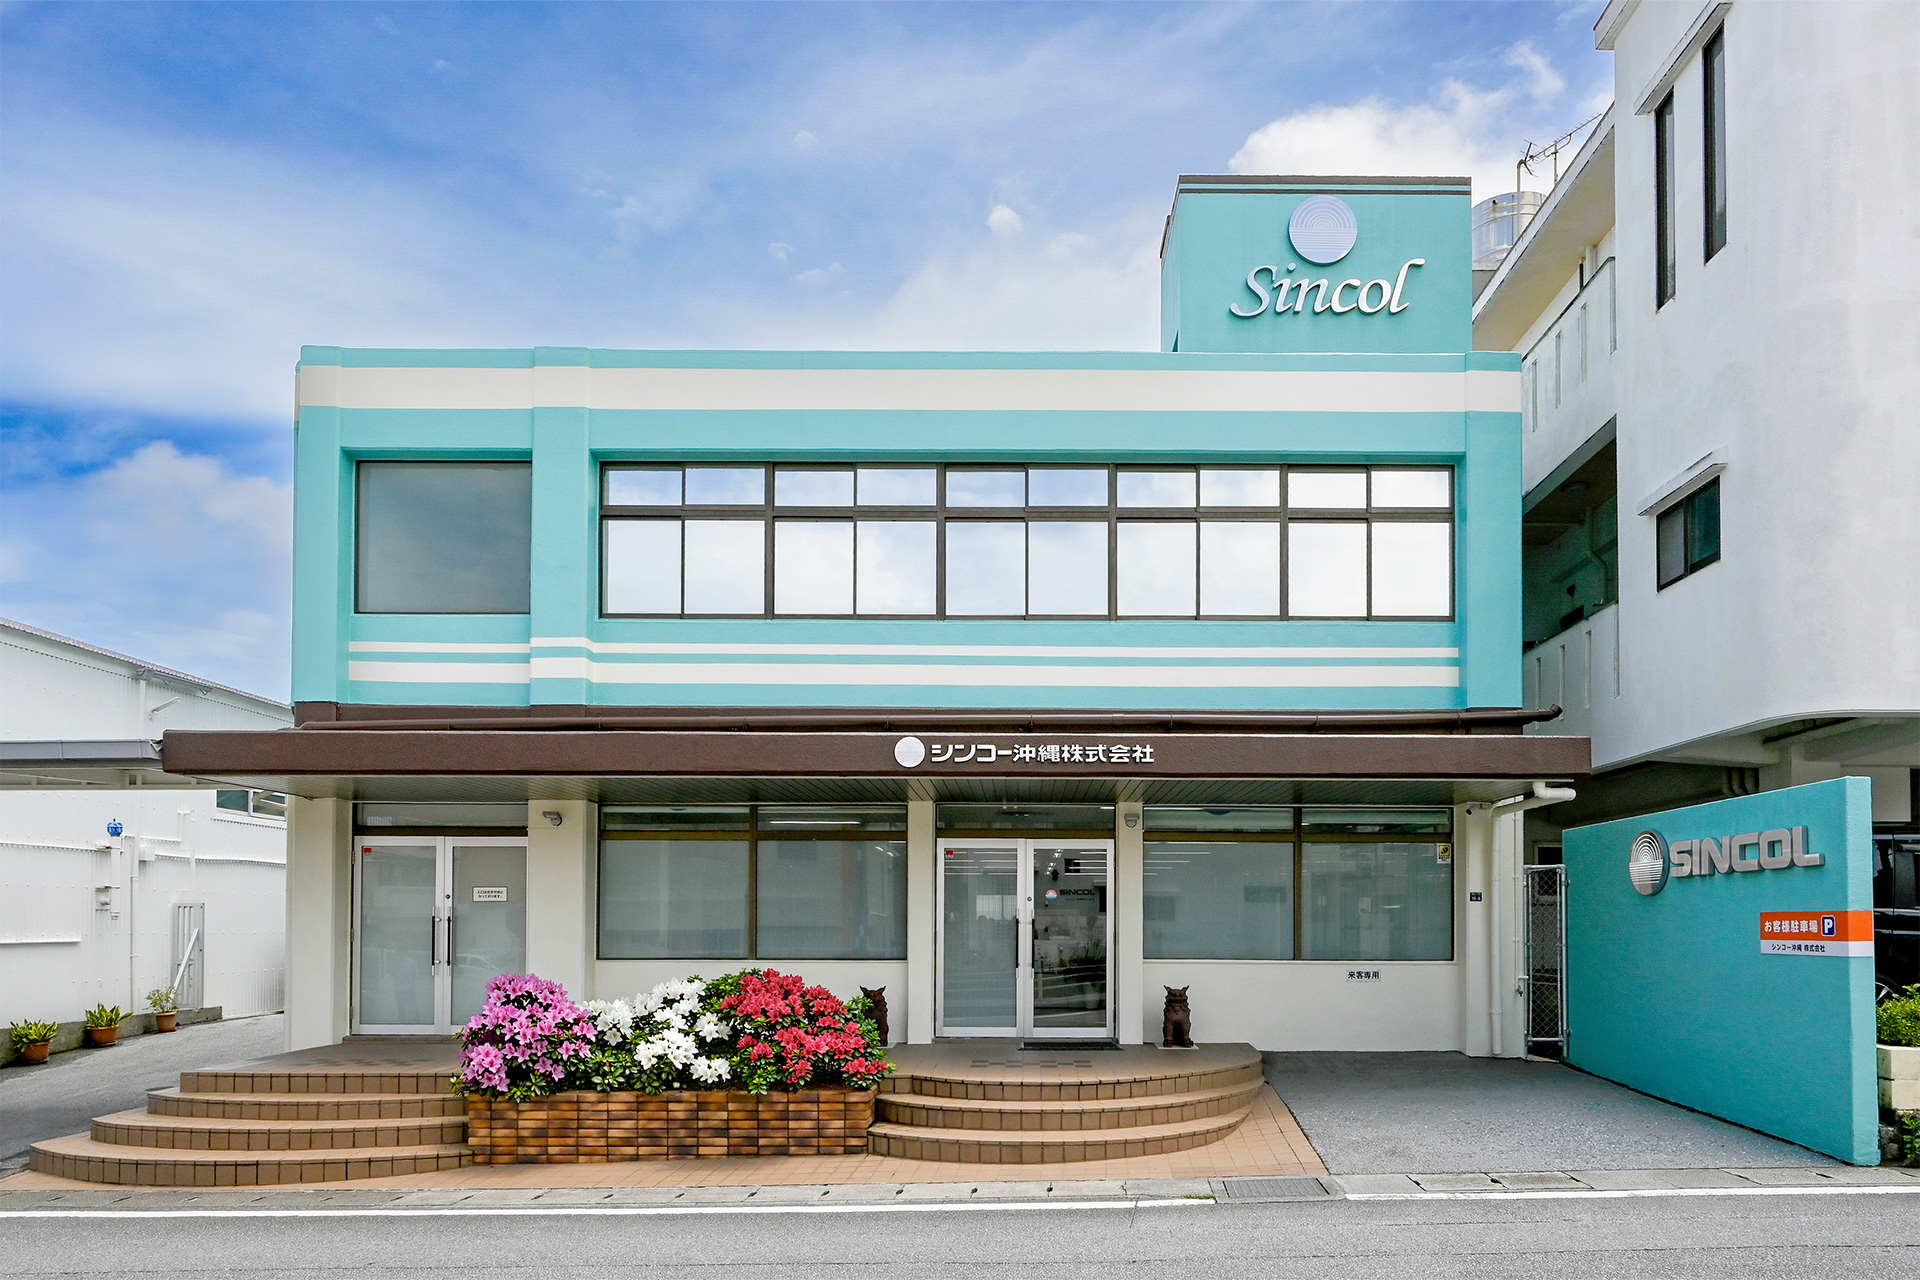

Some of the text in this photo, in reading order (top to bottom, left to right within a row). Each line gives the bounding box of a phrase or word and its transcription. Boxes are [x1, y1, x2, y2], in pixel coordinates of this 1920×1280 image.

[1229, 257, 1427, 320] Sincol
[931, 744, 1155, 763] シンコー沖縄株式会社
[1669, 825, 1826, 878] SINCOL
[1764, 920, 1818, 933] お客様駐車場
